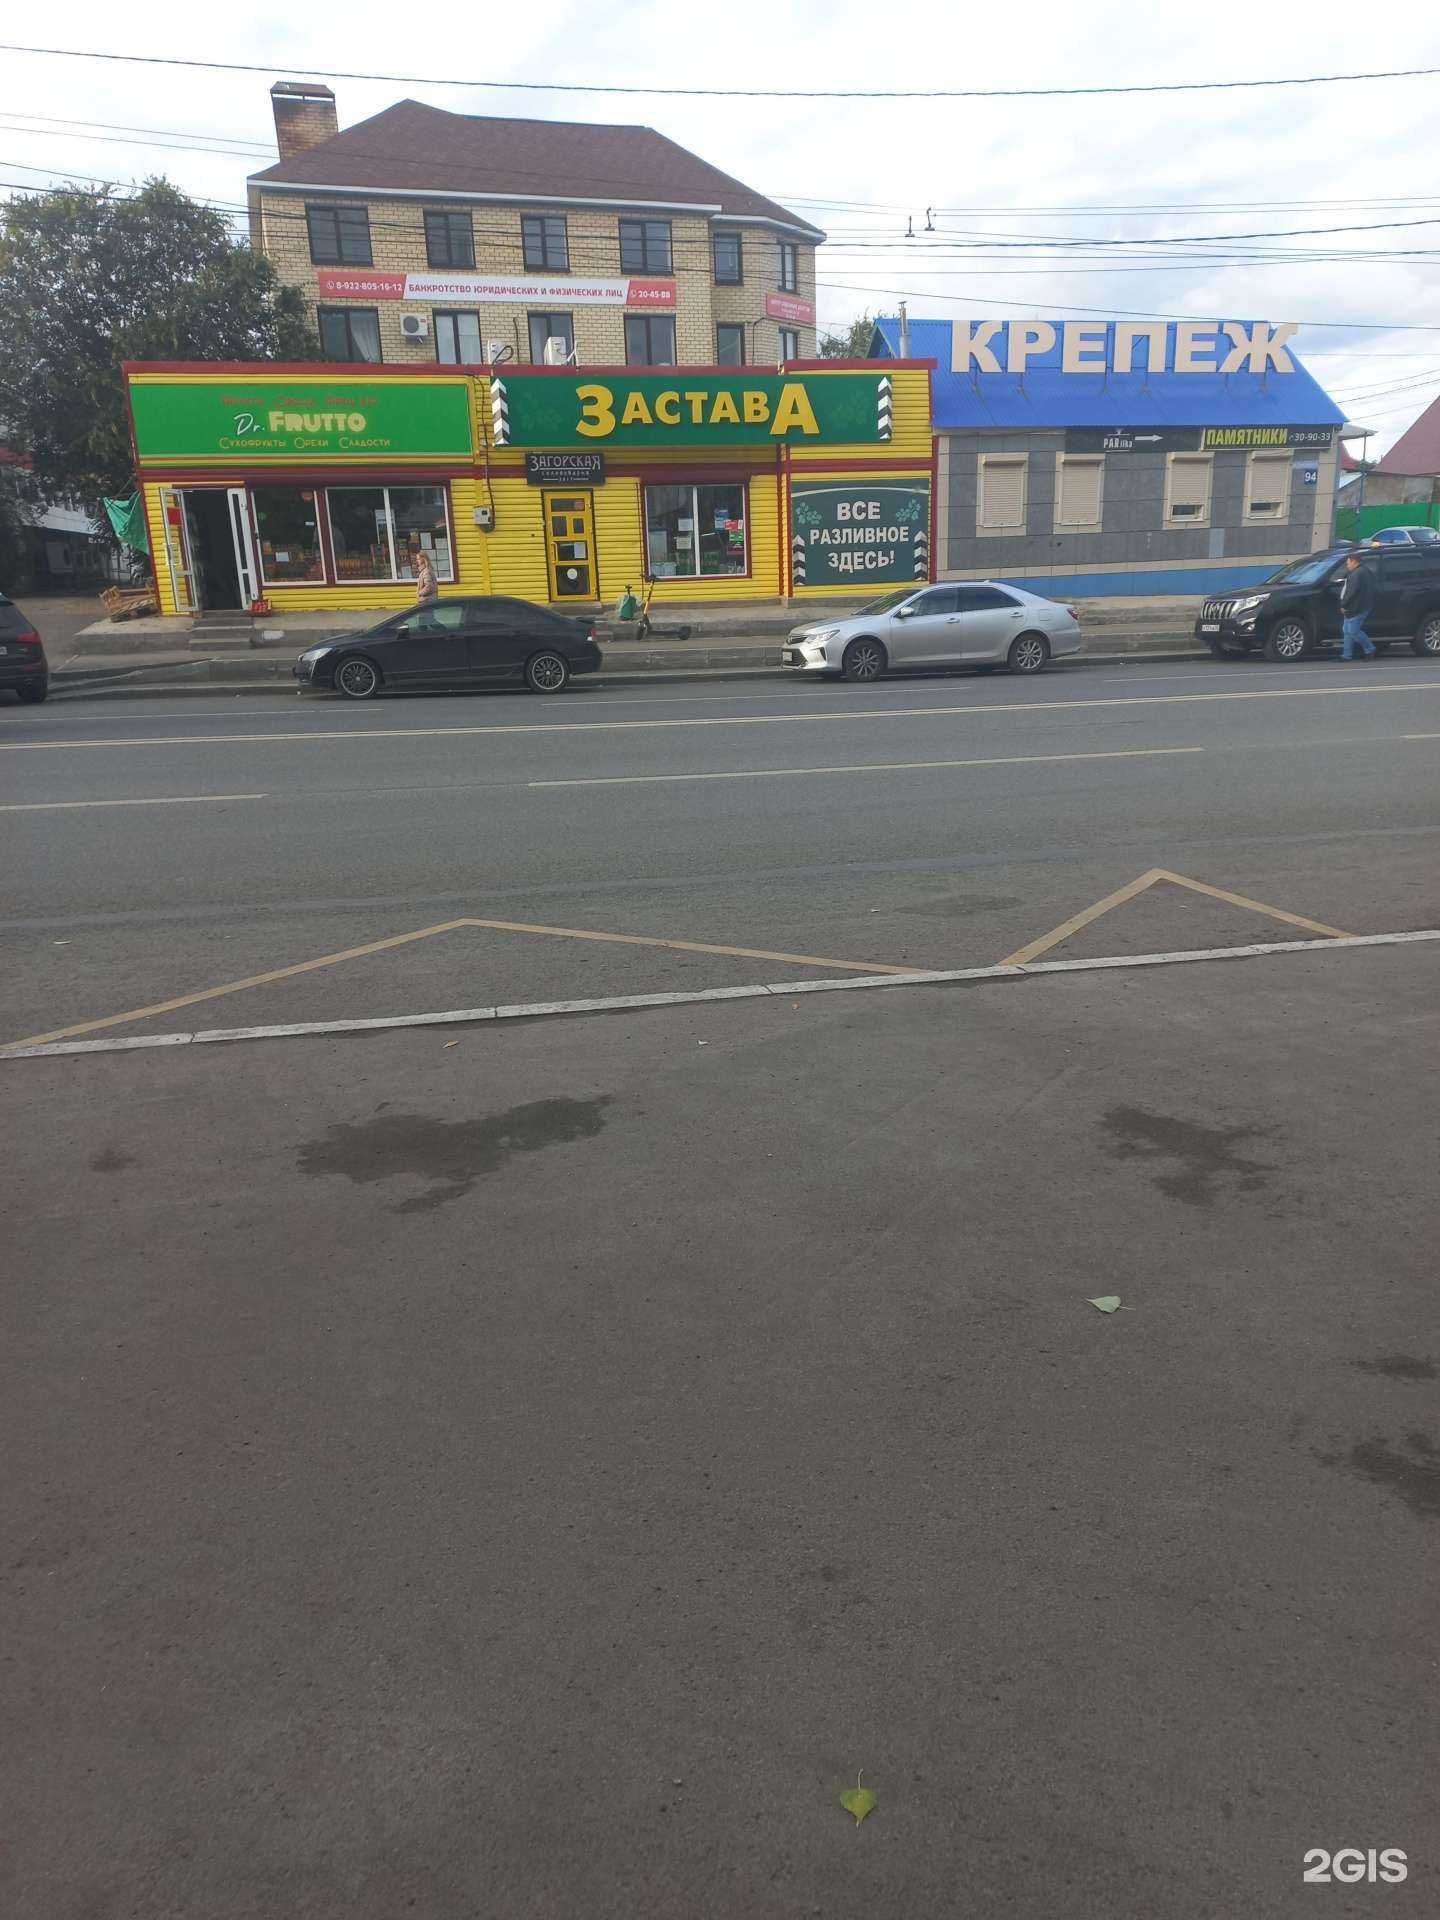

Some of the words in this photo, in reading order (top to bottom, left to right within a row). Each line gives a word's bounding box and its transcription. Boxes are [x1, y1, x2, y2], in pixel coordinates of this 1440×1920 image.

[408, 284, 471, 294] БАНКРОТСТВО
[473, 286, 539, 296] ЮРИДИЧЕСКИХ
[549, 288, 603, 298] ФИЗИЧЕСКИХ
[605, 289, 623, 299] ЛИЦ
[951, 319, 1299, 373] КРЕПЕЖ
[575, 383, 821, 438] ЗАСТАВА
[234, 412, 265, 436] Dr.
[268, 411, 367, 433] FRUTTO
[1205, 428, 1289, 446] ПАМЯТНИКИ
[530, 455, 601, 472] ЗАГОРСКАЯ
[1304, 471, 1317, 482] 94
[837, 501, 881, 521] ВСЕ
[809, 526, 910, 545] РАЗЛИВНОЕ
[827, 550, 896, 574] ЗДЕСЬ!
